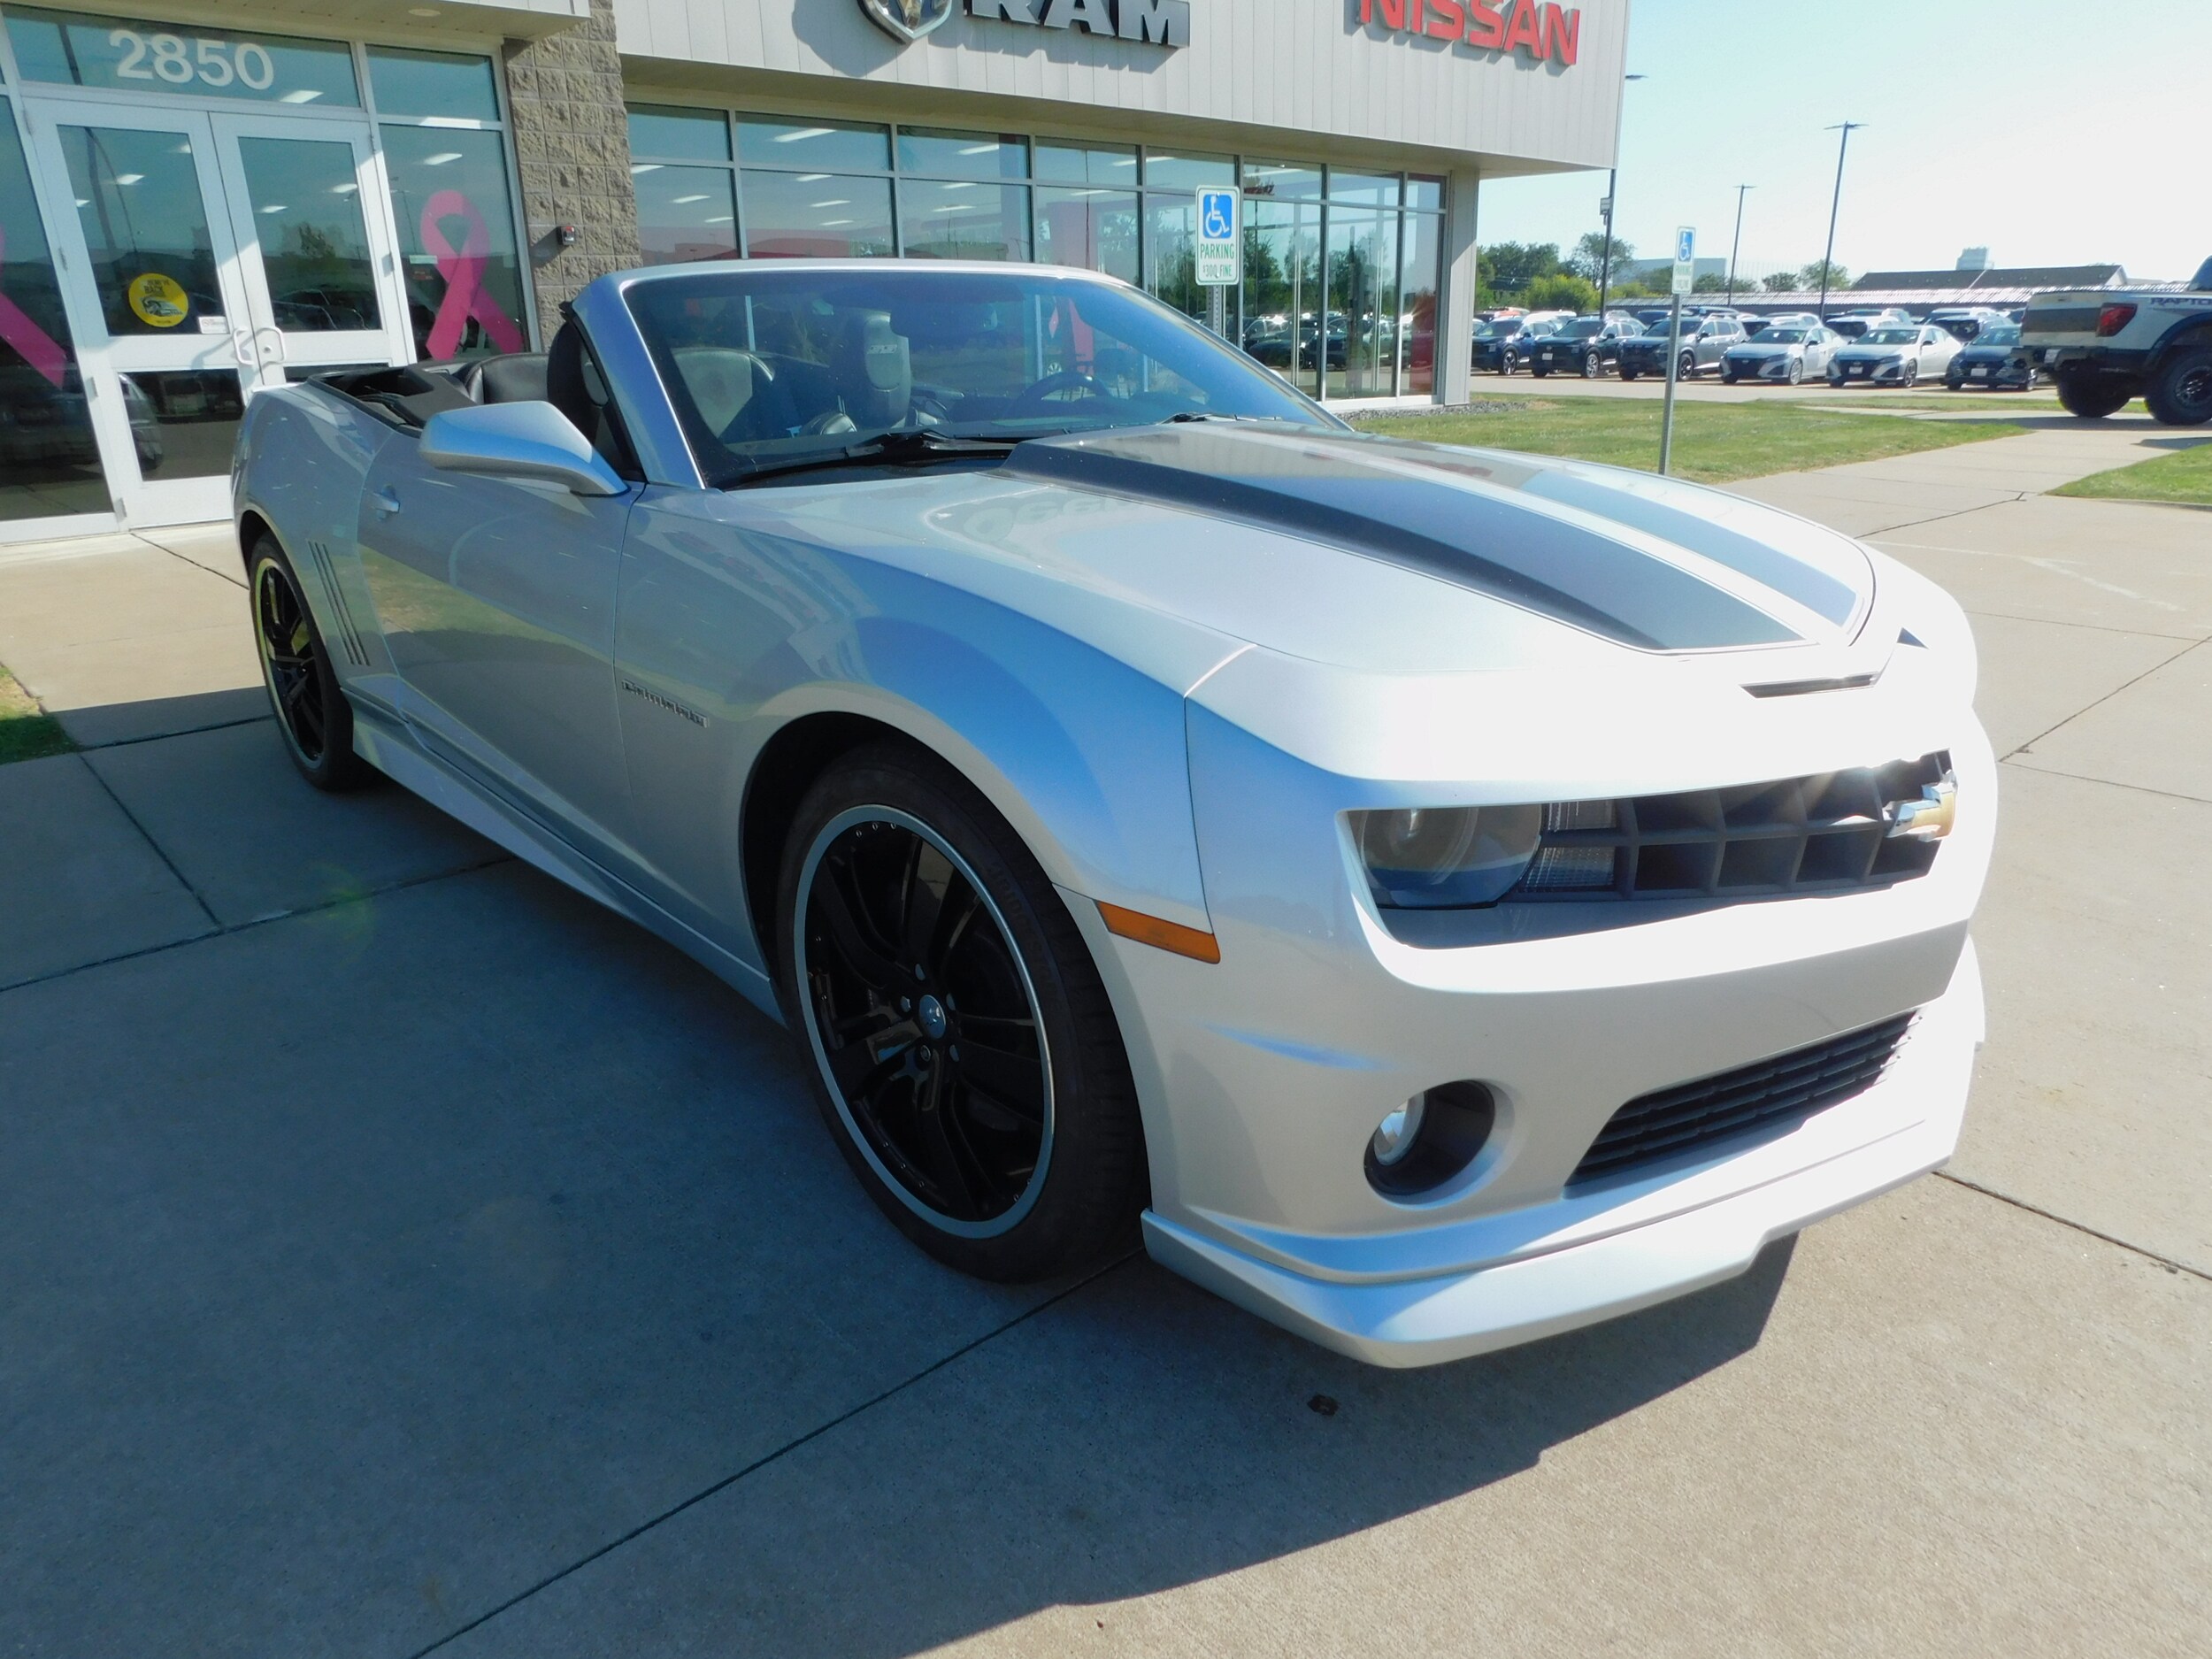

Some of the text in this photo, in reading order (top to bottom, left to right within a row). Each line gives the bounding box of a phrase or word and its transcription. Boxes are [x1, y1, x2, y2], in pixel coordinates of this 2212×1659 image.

[110, 29, 274, 90] 2850
[1200, 243, 1235, 259] PARKING
[1202, 265, 1233, 277] $300 FINE
